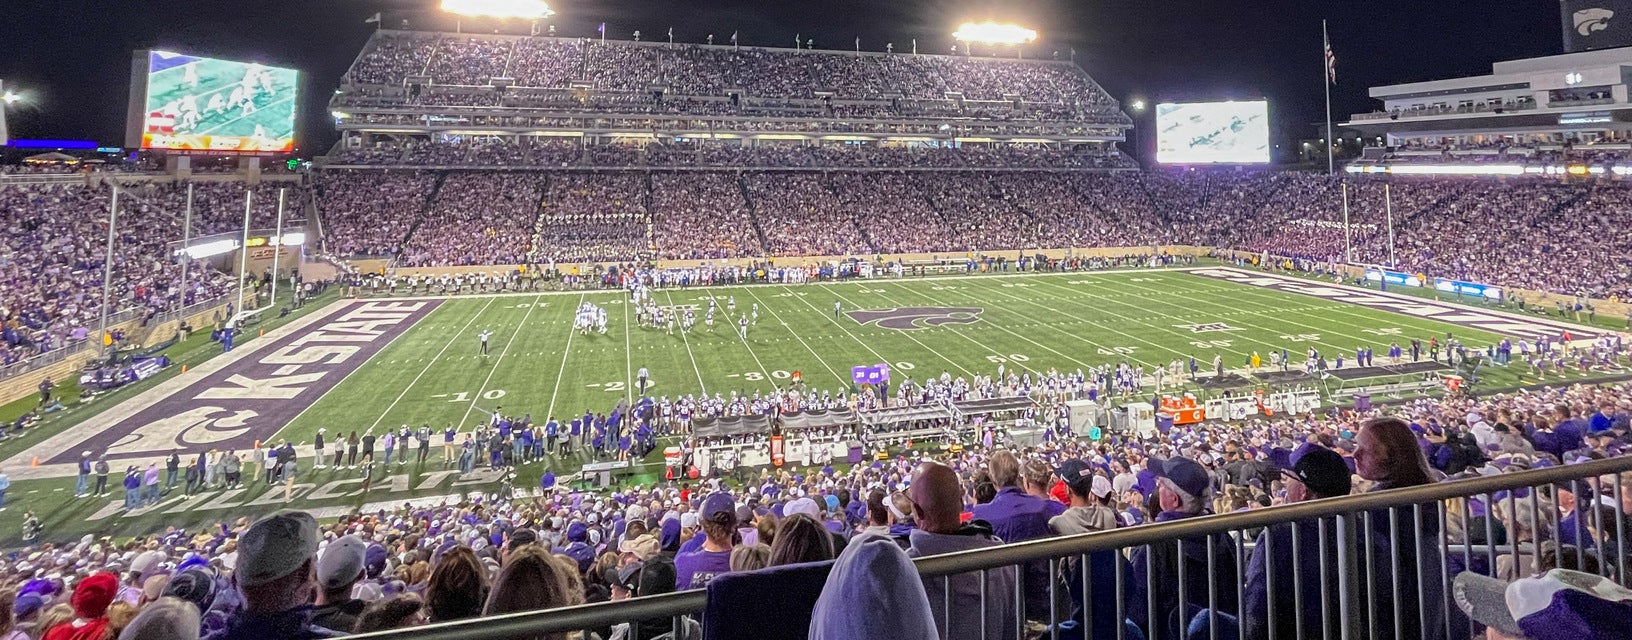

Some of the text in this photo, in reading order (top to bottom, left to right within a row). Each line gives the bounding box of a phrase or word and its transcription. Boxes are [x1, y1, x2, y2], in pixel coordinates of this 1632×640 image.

[192, 301, 429, 399] K-STATE
[1097, 346, 1135, 355] 40
[986, 353, 1030, 363] 50
[895, 361, 915, 370] 0
[744, 370, 791, 381] 30
[604, 379, 655, 391] 20
[448, 389, 506, 402] 10
[1173, 412, 1181, 421] G
[1192, 410, 1200, 420] G
